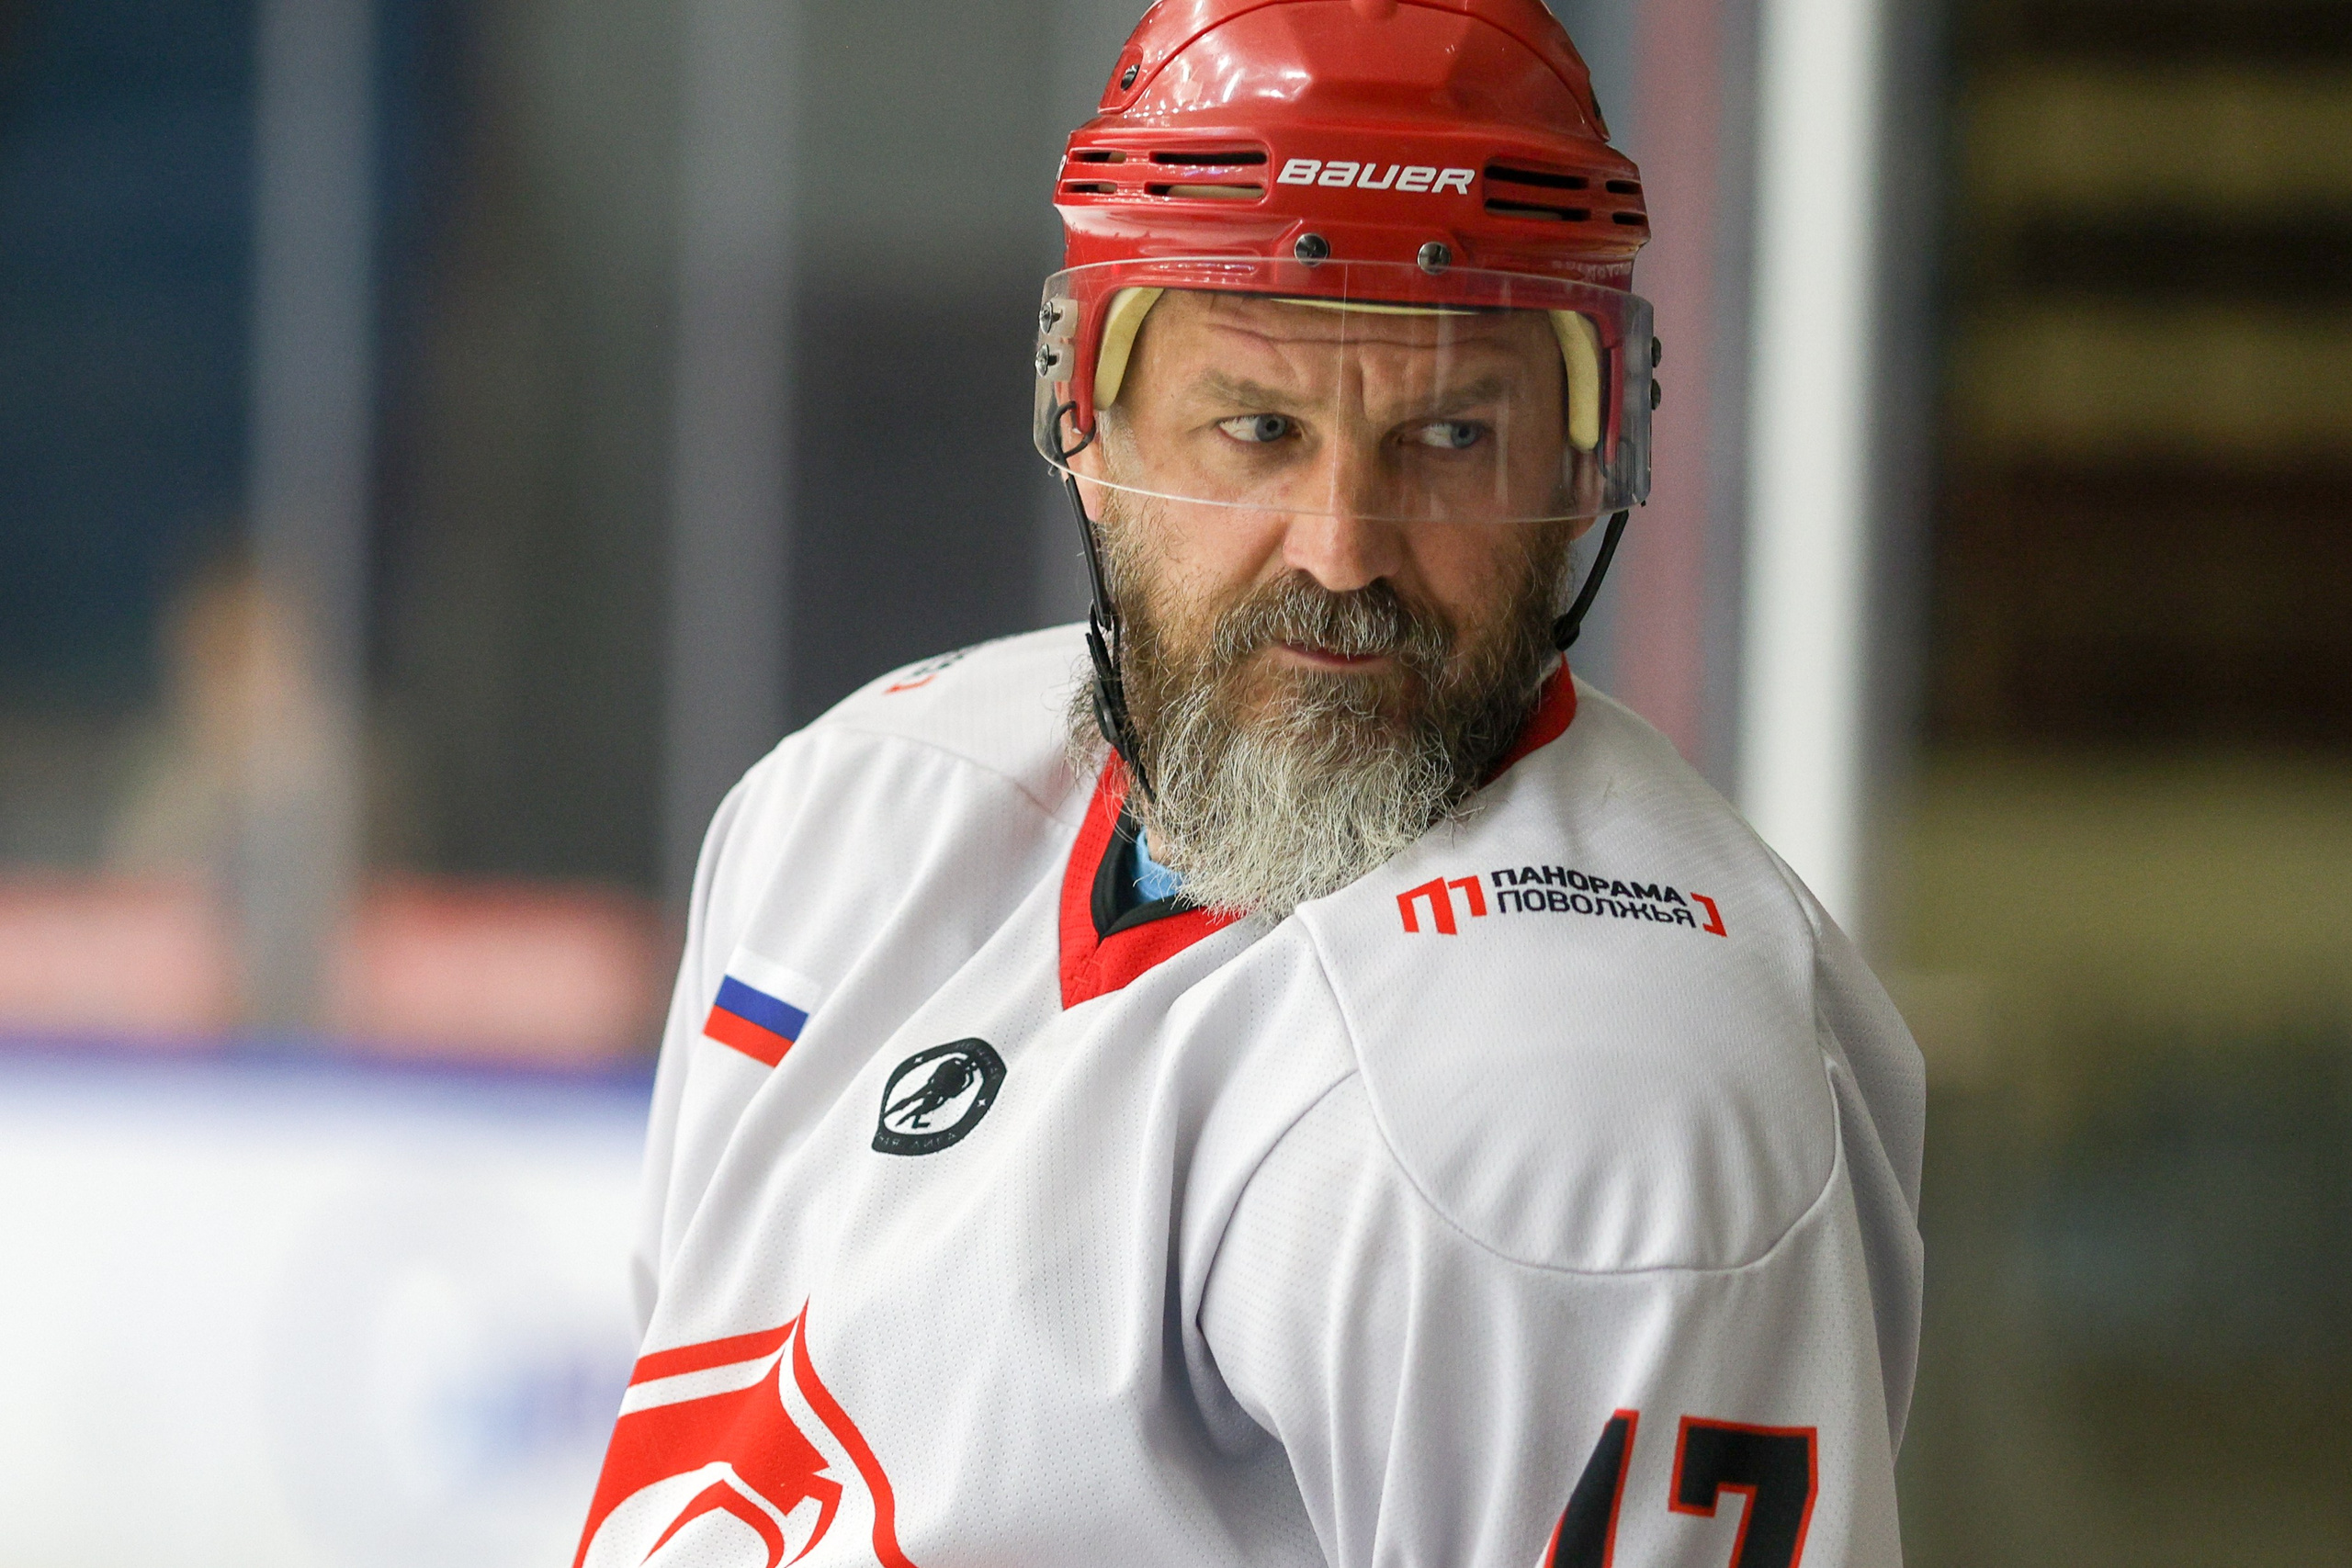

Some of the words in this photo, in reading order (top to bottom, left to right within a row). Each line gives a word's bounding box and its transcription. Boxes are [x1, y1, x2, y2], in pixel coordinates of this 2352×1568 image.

[1277, 158, 1476, 195] BAUER
[1490, 865, 1688, 906] ПАНОРАМА
[1497, 888, 1697, 928] ПОВОЛЖЬЯ
